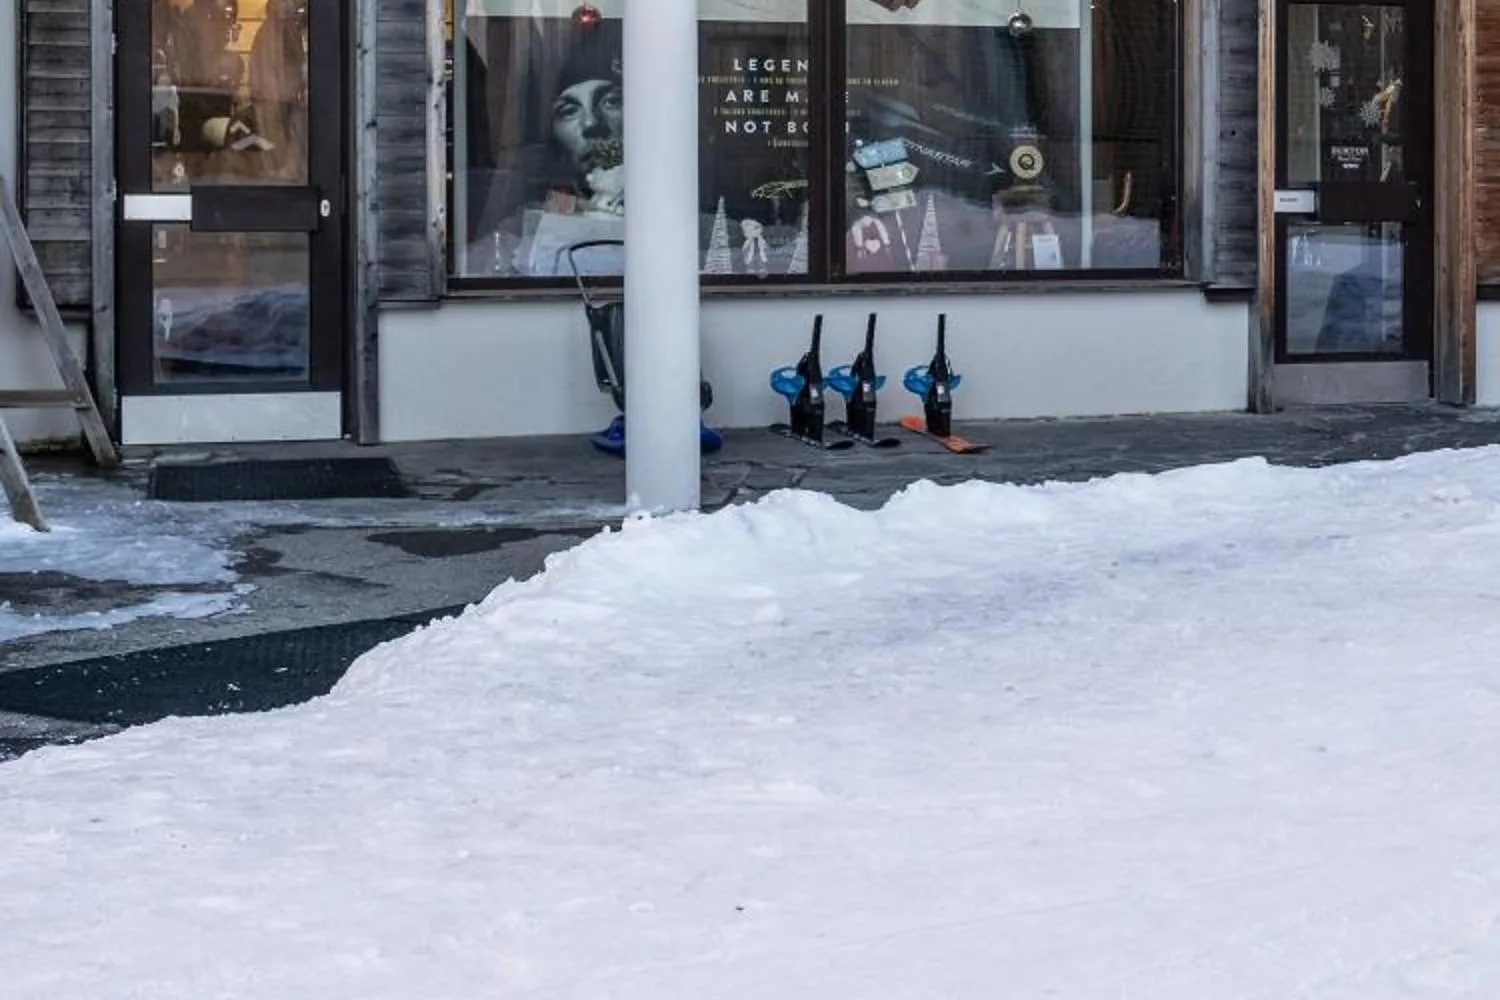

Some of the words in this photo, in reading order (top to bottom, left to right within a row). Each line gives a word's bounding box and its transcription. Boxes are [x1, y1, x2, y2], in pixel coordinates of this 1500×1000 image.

[733, 58, 809, 72] LEGEN
[725, 89, 770, 103] ARE
[725, 120, 772, 134] NOT
